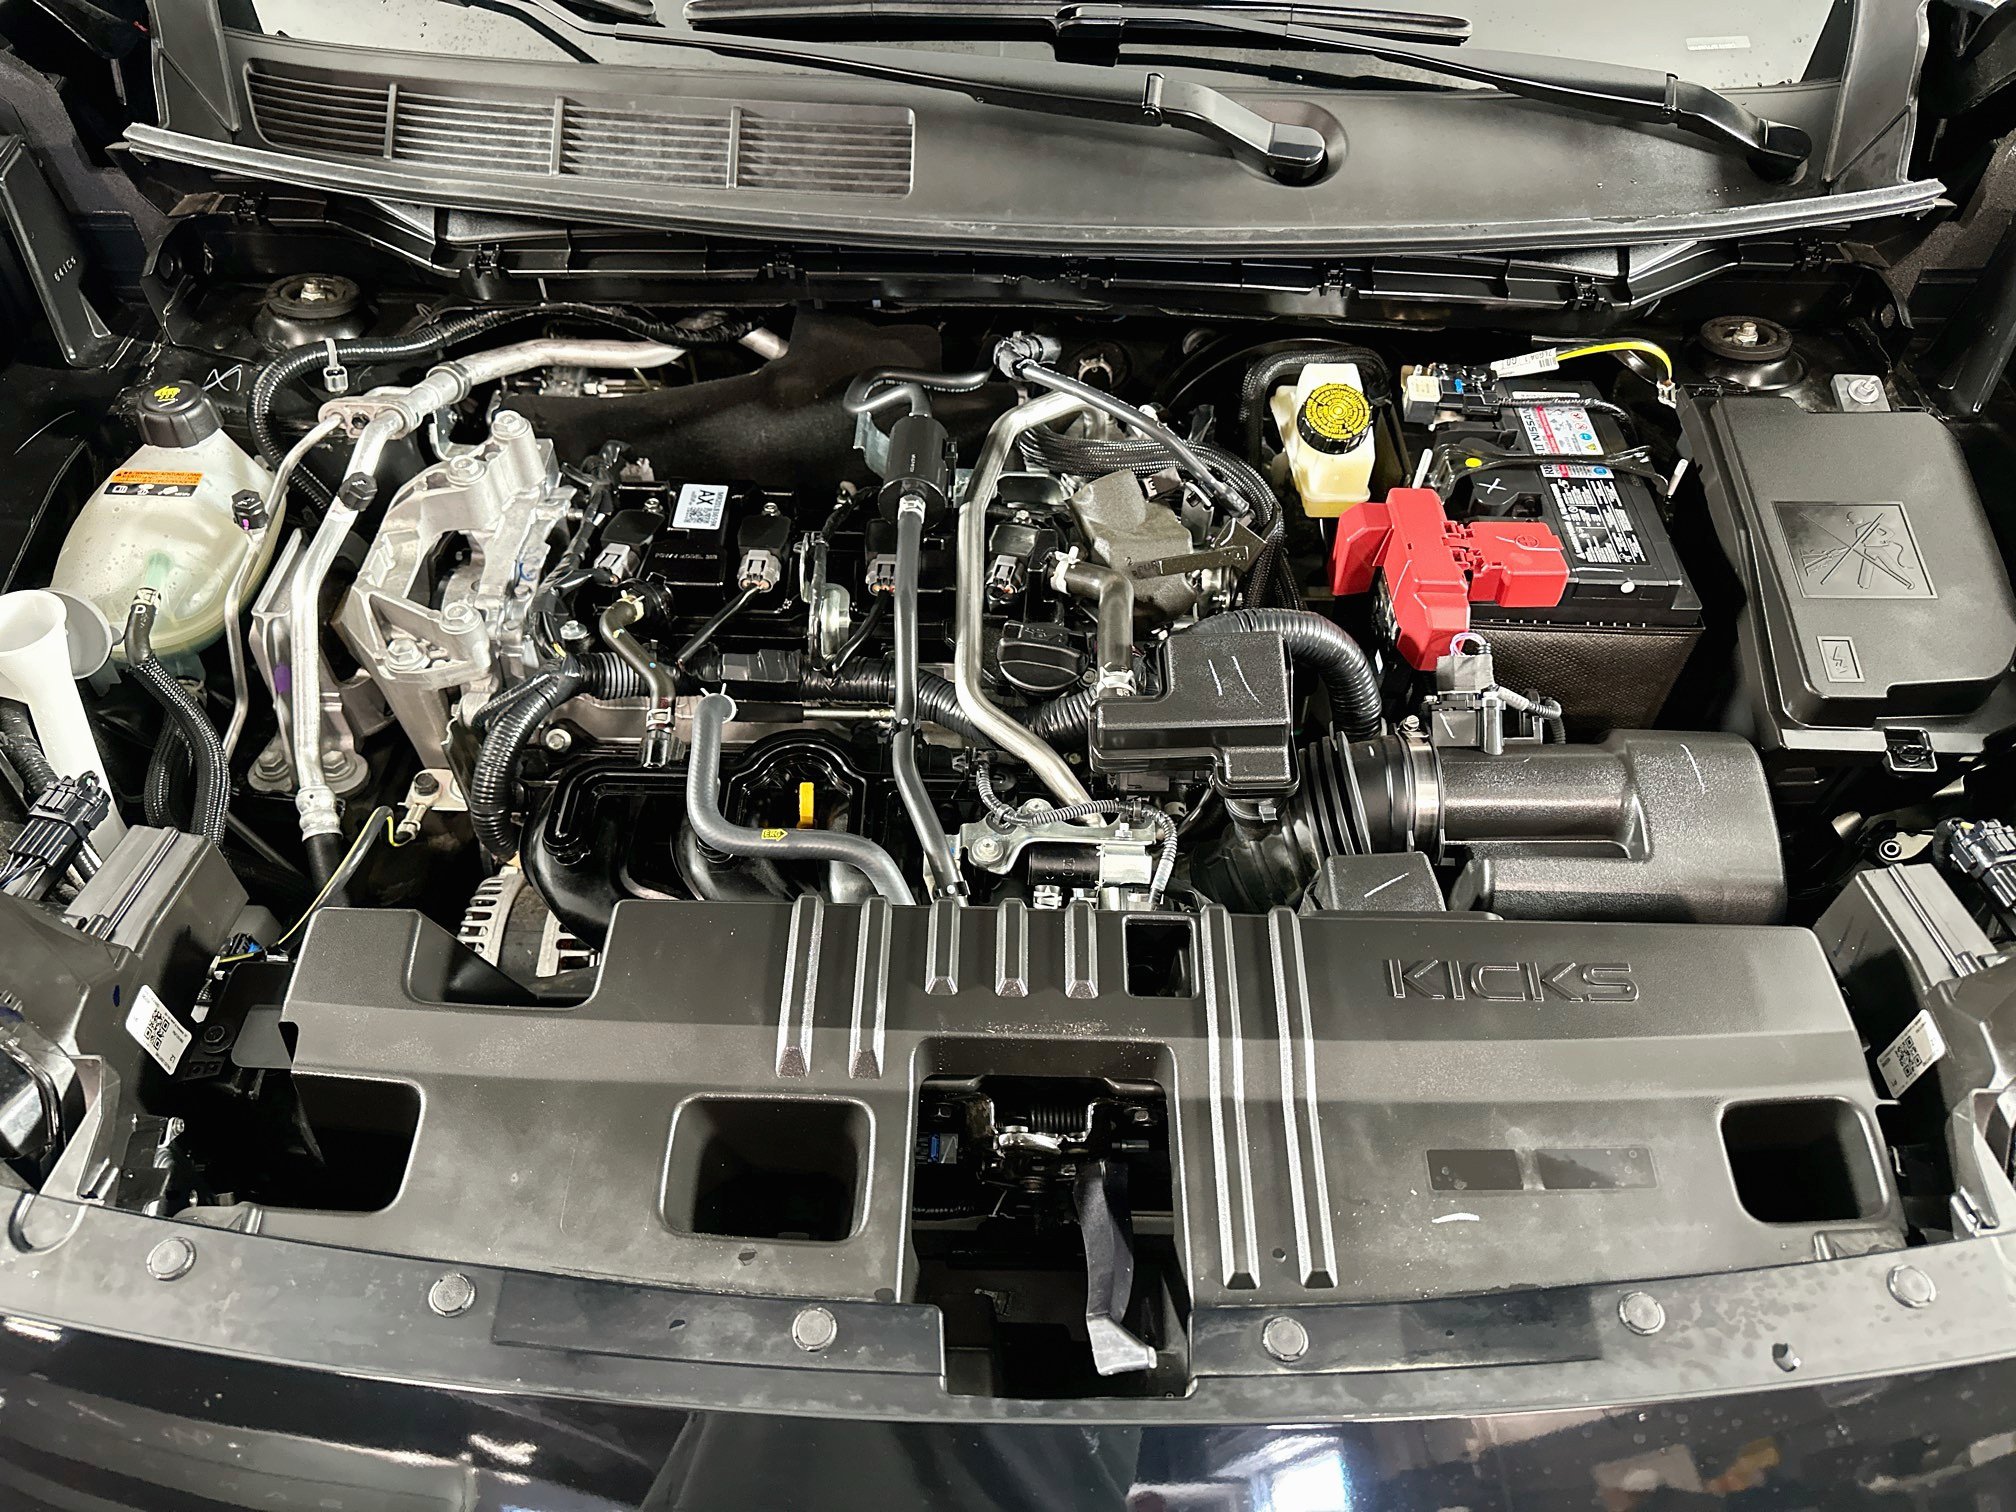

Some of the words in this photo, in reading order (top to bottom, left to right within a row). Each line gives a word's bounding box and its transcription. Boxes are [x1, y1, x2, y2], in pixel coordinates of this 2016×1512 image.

[1523, 407, 1541, 441] NISSAN
[696, 489, 715, 505] AX
[1387, 958, 1640, 1003] KICKS
